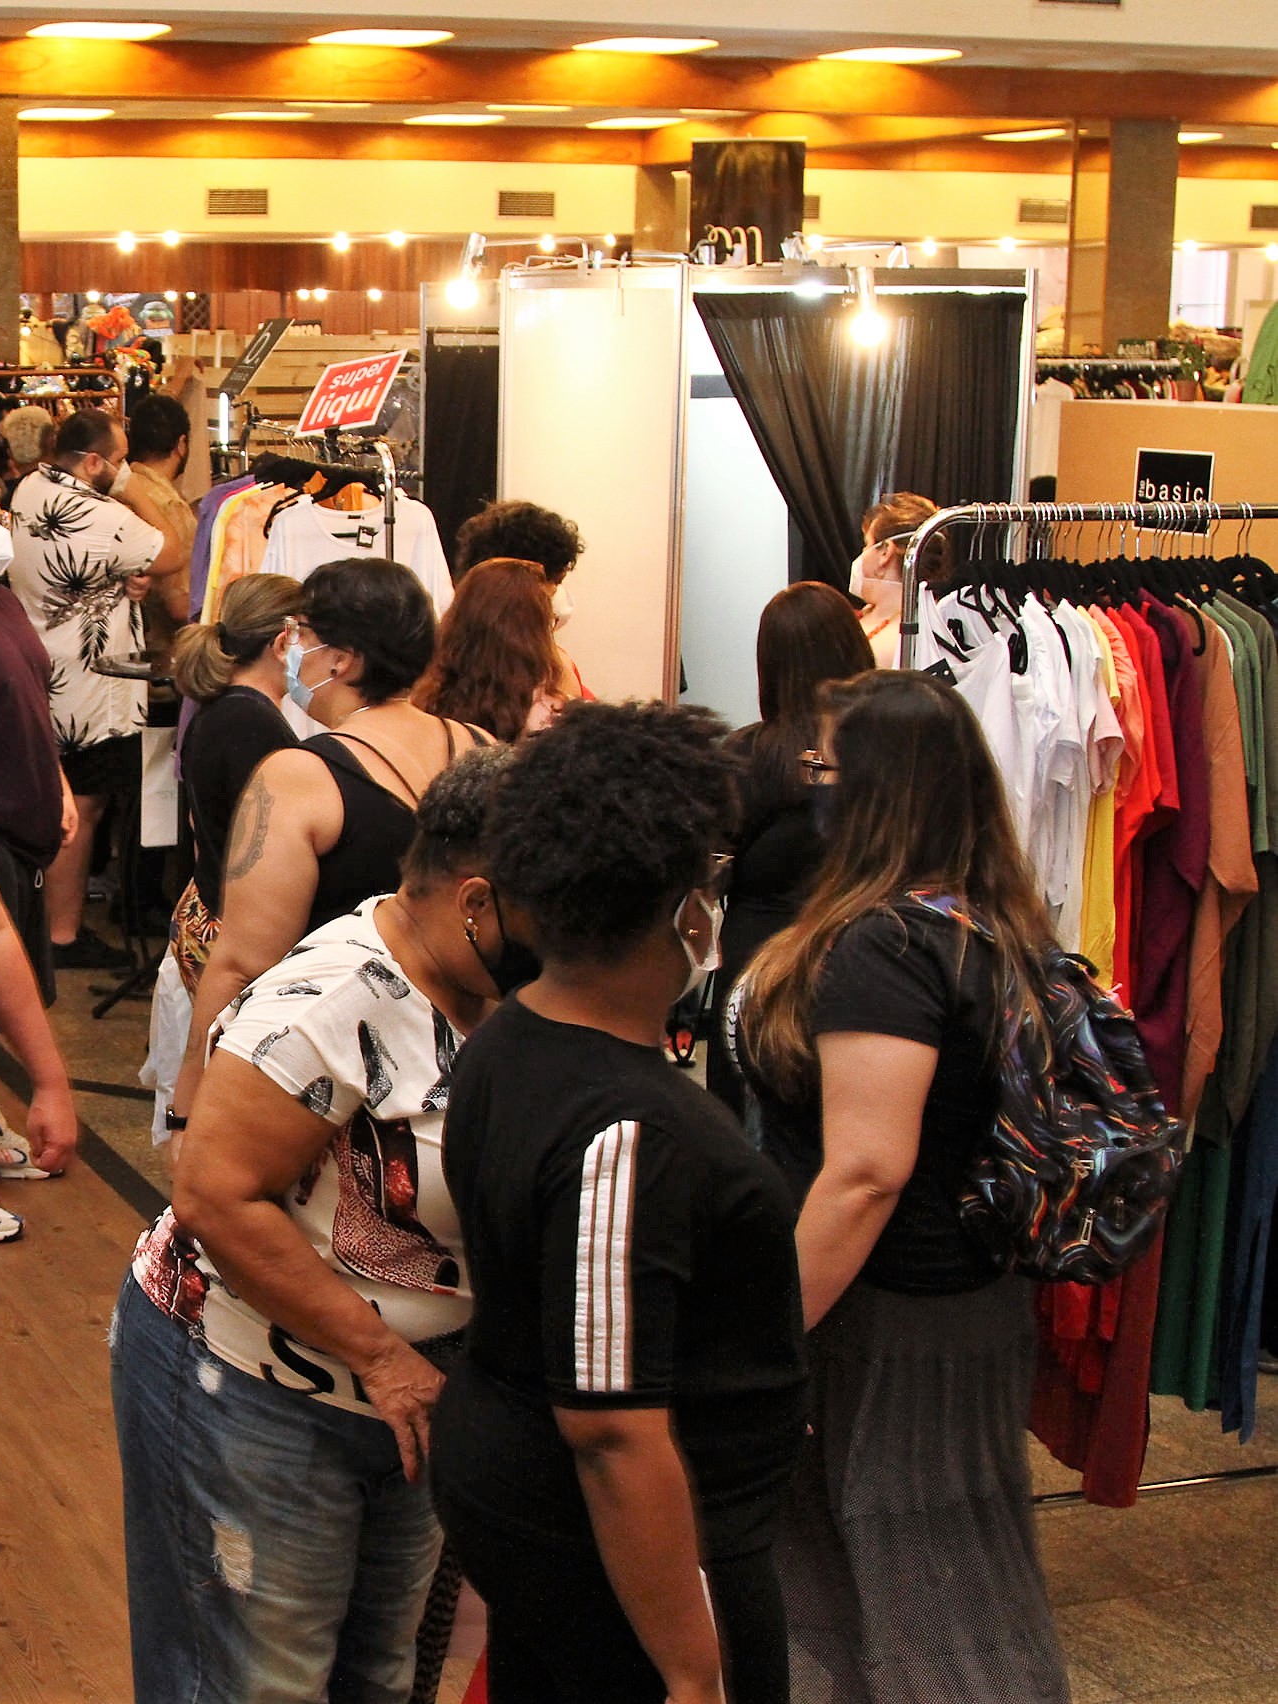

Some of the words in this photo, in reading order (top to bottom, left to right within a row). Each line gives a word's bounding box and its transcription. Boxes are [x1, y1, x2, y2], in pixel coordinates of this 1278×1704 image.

[328, 359, 390, 389] super
[308, 377, 384, 425] liqui
[1145, 478, 1204, 503] basic
